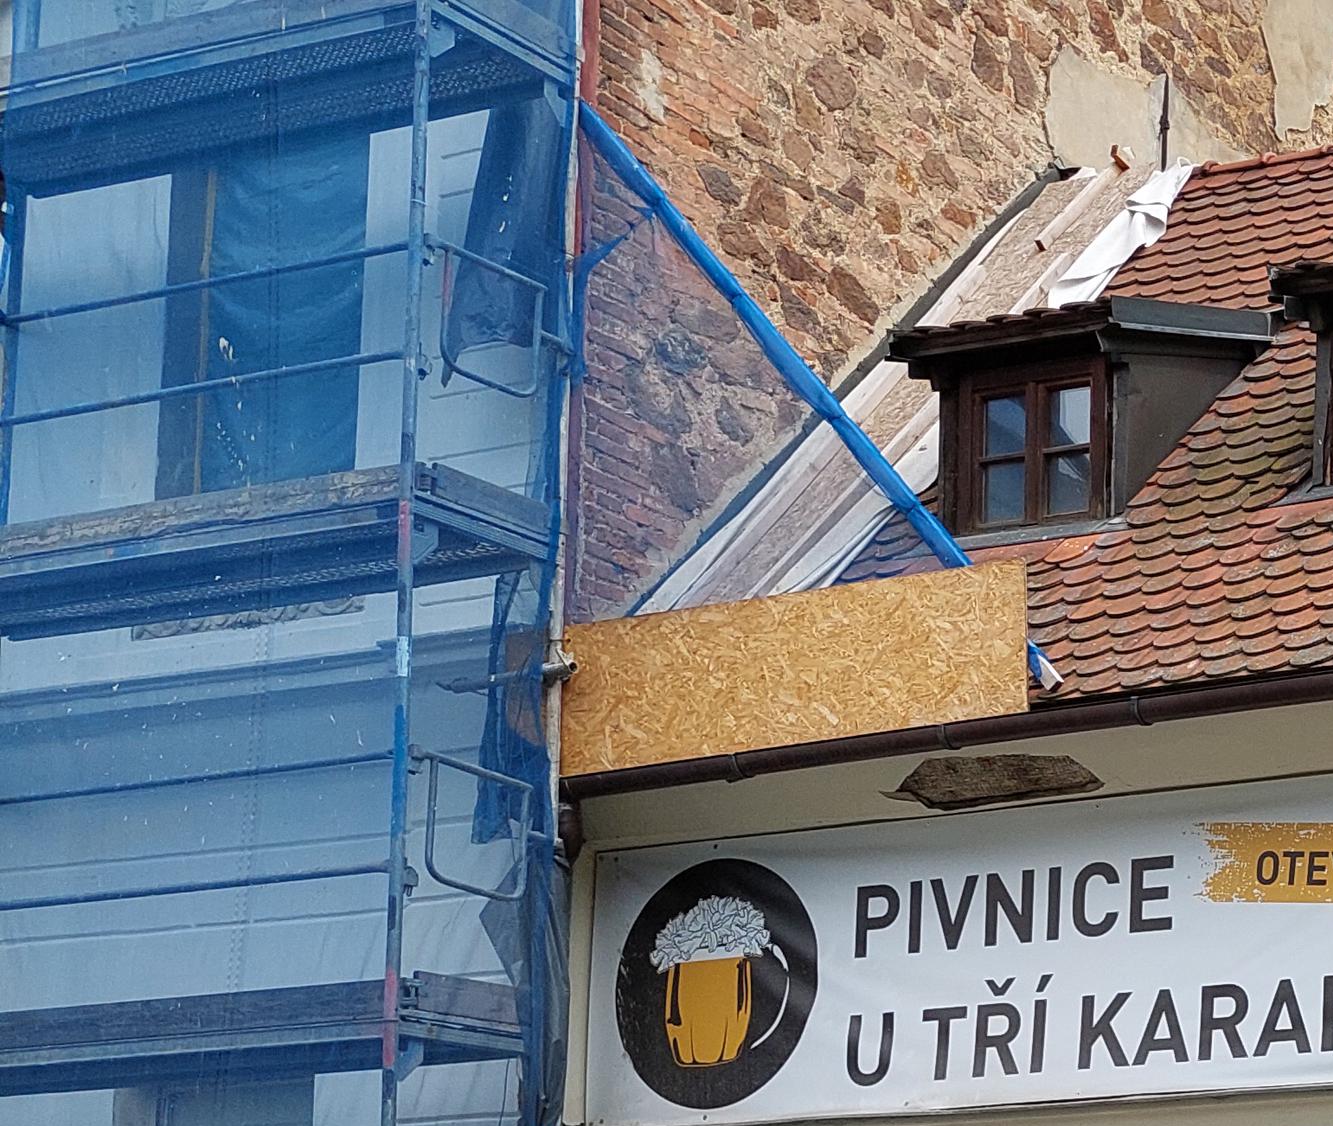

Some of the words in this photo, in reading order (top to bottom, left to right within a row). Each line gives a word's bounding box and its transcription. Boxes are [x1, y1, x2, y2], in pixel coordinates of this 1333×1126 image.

[853, 855, 1175, 958] PIVNICE
[846, 1011, 894, 1087] U
[922, 973, 1053, 1081] TŘÍ
